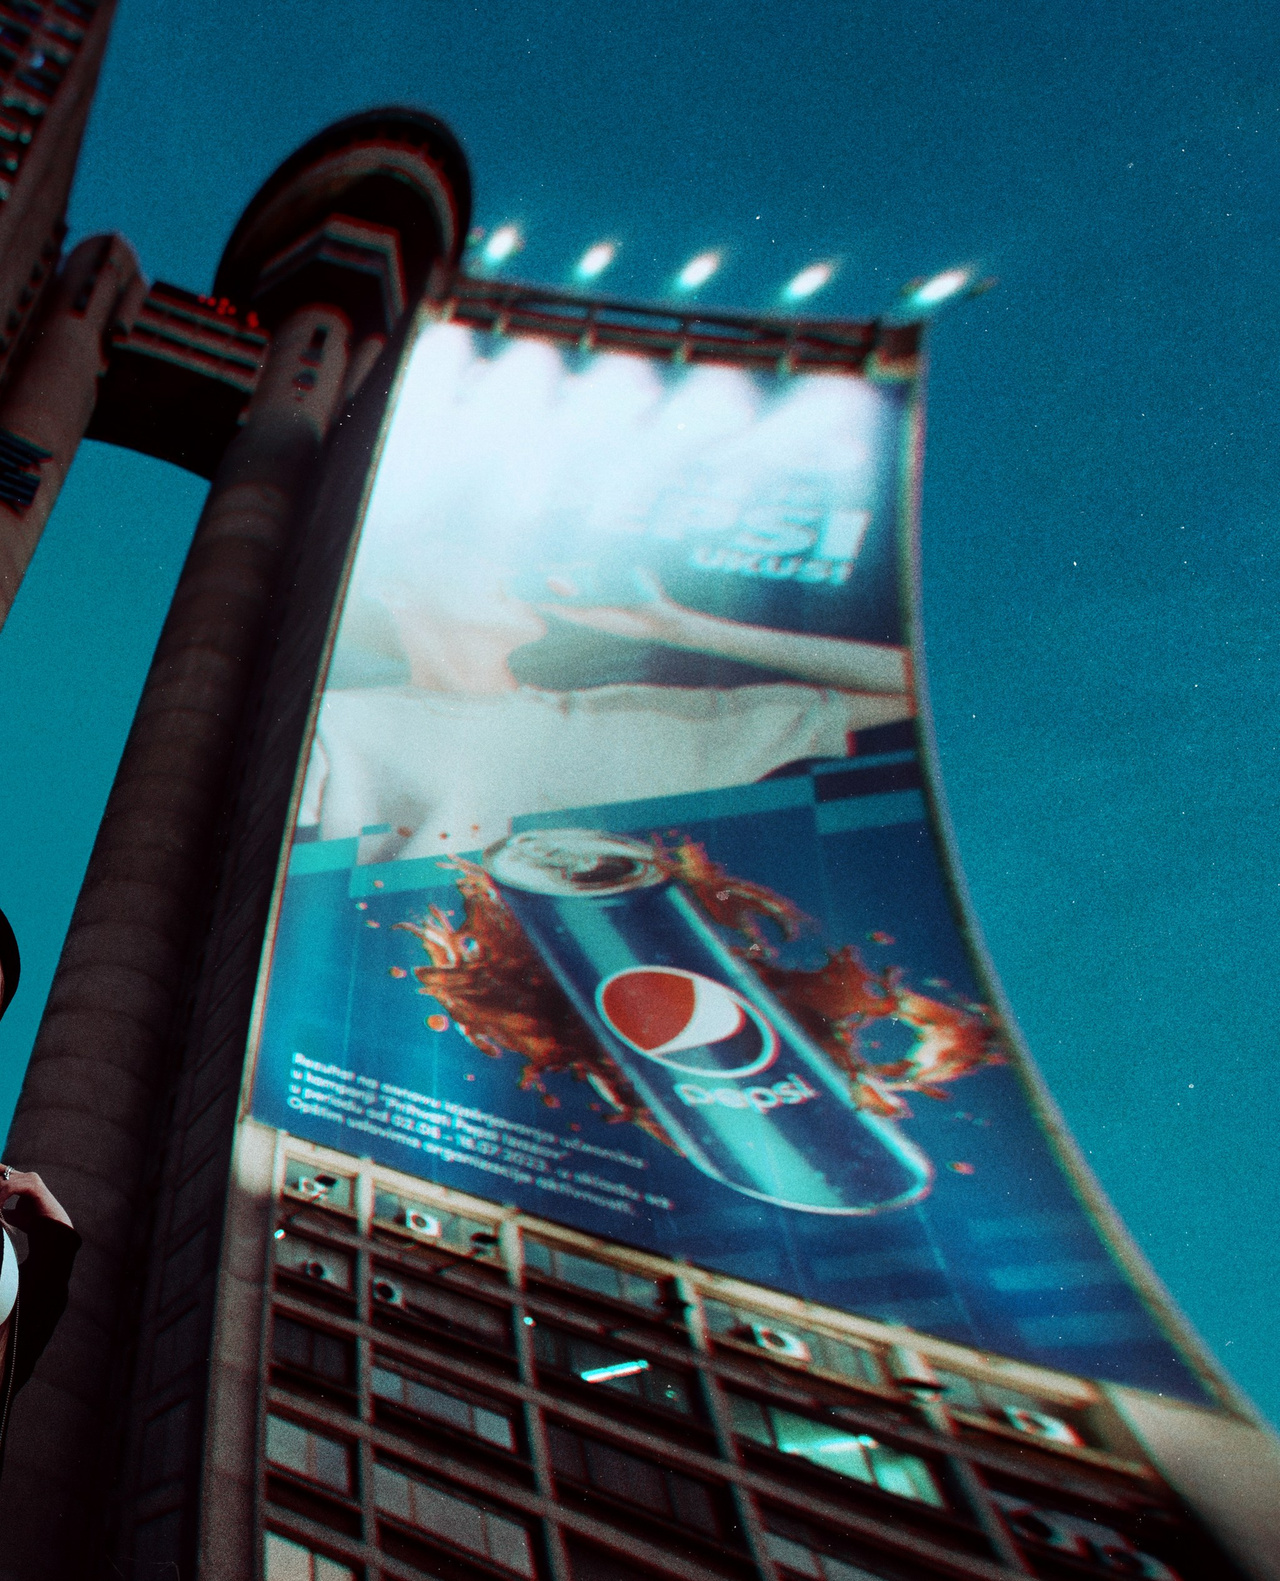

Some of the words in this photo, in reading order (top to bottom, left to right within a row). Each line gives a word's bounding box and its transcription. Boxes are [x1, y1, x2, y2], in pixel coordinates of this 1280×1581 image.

[290, 1069, 303, 1080] u
[303, 1071, 378, 1105] kampanji
[293, 1052, 356, 1081] Rezultat
[357, 1075, 379, 1089] na
[380, 1083, 441, 1109] osnovu
[673, 1072, 821, 1114] pepsi
[289, 1084, 301, 1094] u
[302, 1087, 365, 1115] periodu
[366, 1107, 391, 1123] od
[287, 1095, 345, 1123] Opštim
[346, 1117, 422, 1149] uslovima
[422, 1141, 535, 1184] organizacije
